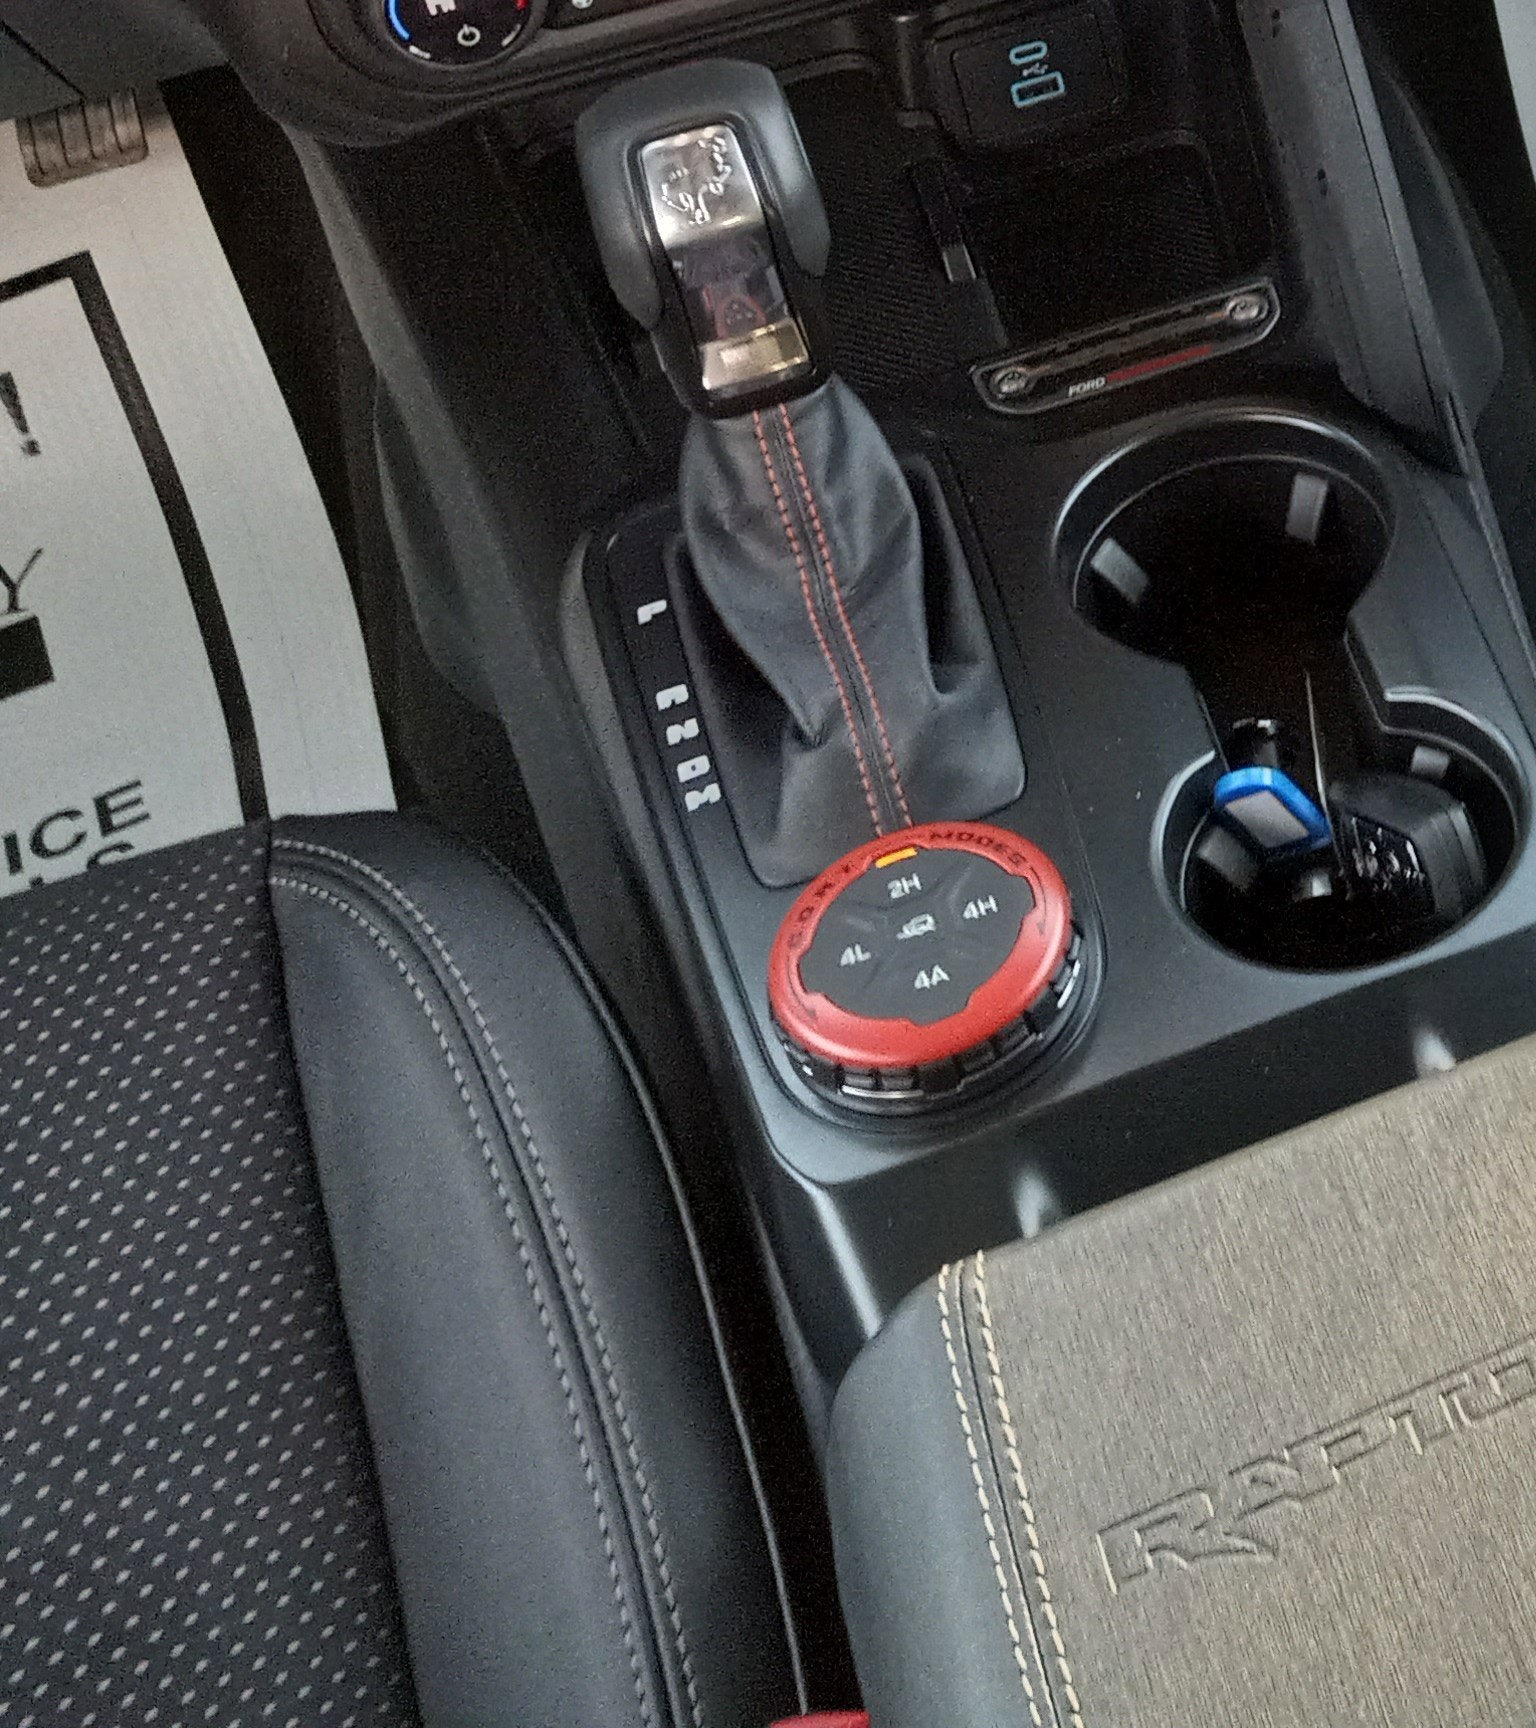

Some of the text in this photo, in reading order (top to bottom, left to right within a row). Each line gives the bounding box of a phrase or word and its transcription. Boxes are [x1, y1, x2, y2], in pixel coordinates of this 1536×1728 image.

[1068, 377, 1106, 396] FORD
[887, 873, 922, 899] 2H
[963, 895, 999, 920] 4H
[840, 944, 872, 967] 4L
[914, 964, 950, 989] 4A
